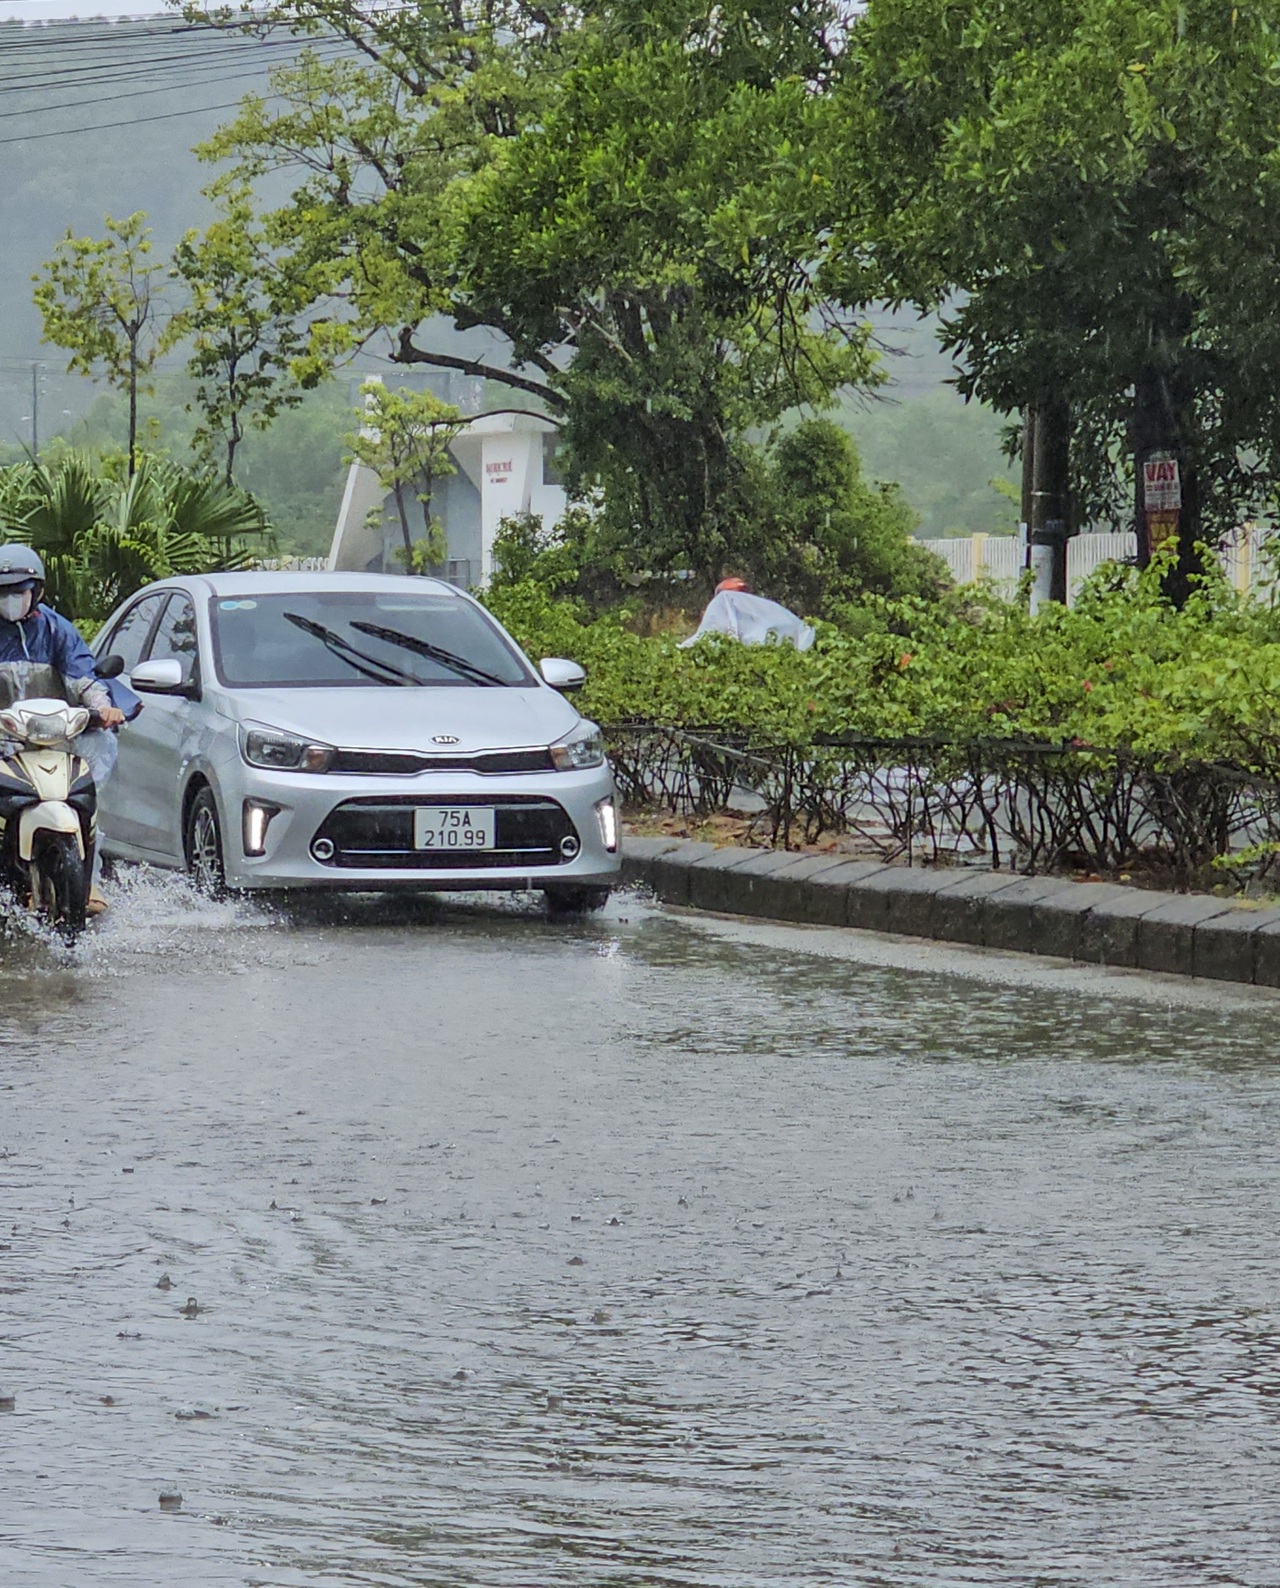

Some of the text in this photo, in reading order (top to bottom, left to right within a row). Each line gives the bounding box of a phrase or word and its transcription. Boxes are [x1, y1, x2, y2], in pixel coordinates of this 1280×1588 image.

[435, 735, 457, 743] KIA
[439, 810, 472, 828] 75A
[424, 829, 486, 847] 210.99
